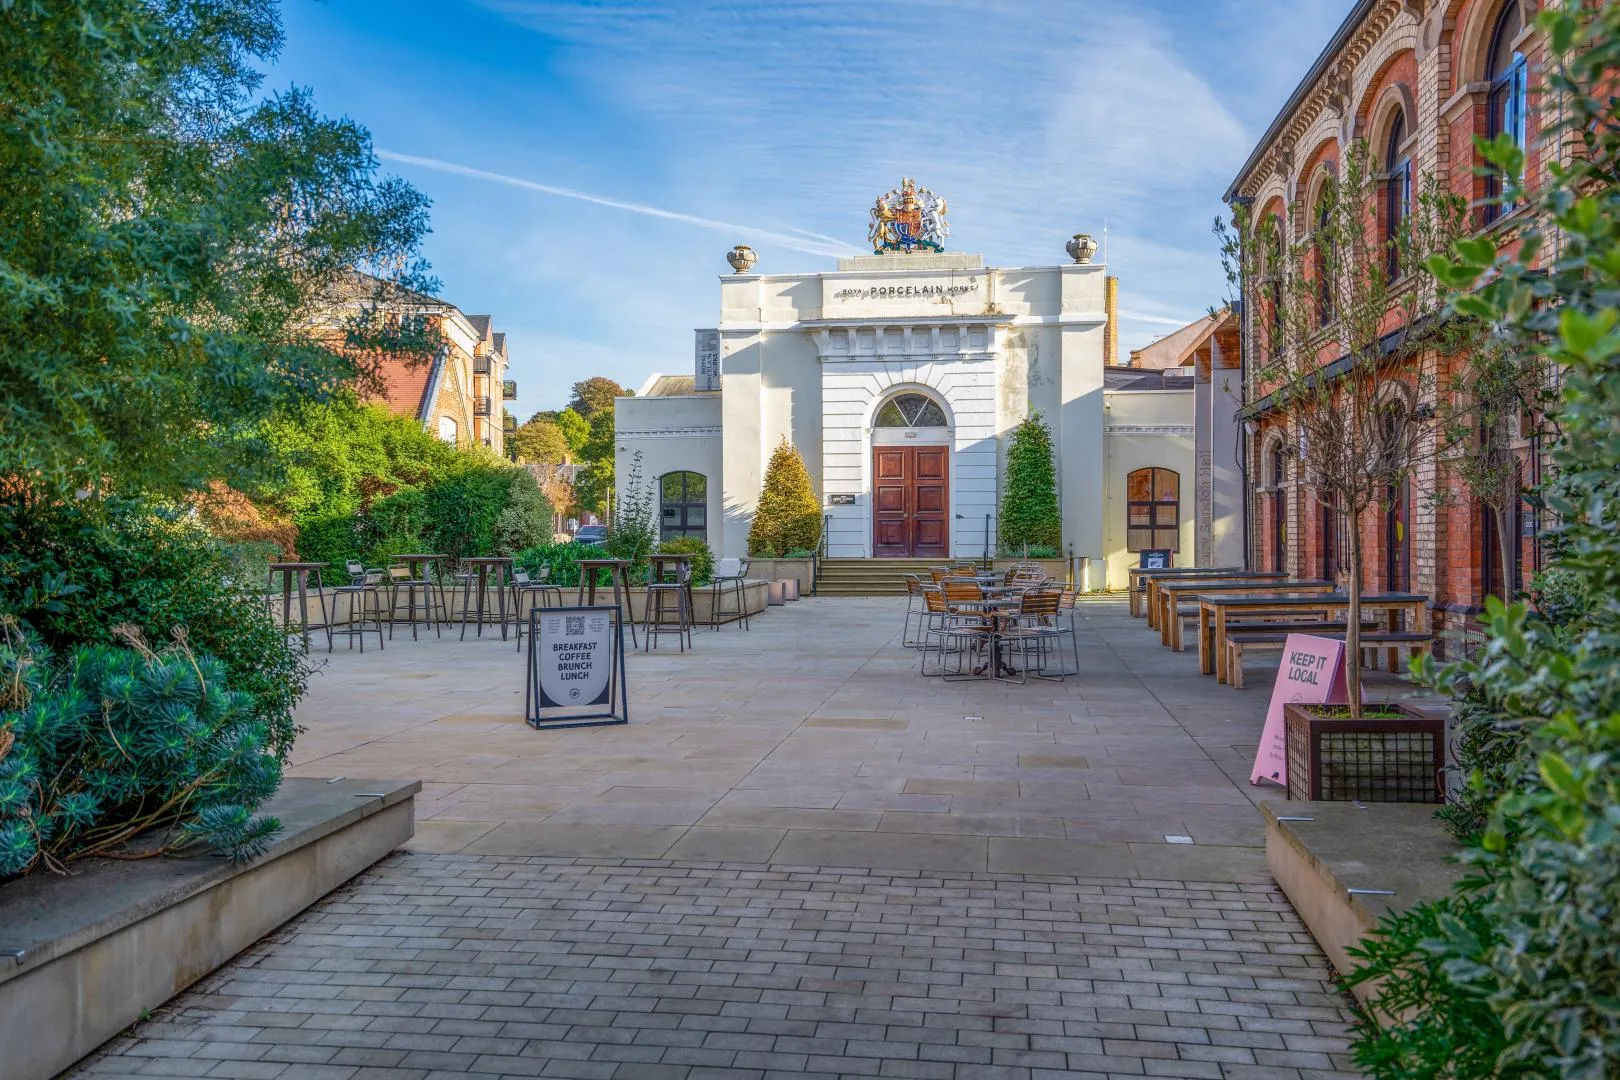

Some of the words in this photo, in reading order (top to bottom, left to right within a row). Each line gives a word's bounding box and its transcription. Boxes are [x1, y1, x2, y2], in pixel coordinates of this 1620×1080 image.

[870, 285, 944, 295] PORCELAIN
[1199, 450, 1211, 476] Hall
[1199, 481, 1211, 532] Sandon
[553, 642, 597, 652] BREAKFAST
[559, 652, 591, 661] COFFEE
[1289, 652, 1315, 667] KEEP
[1316, 657, 1327, 670] IT
[558, 661, 592, 670] BRUNCH
[561, 672, 588, 680] LUNCH
[1288, 668, 1318, 685] LOCAL
